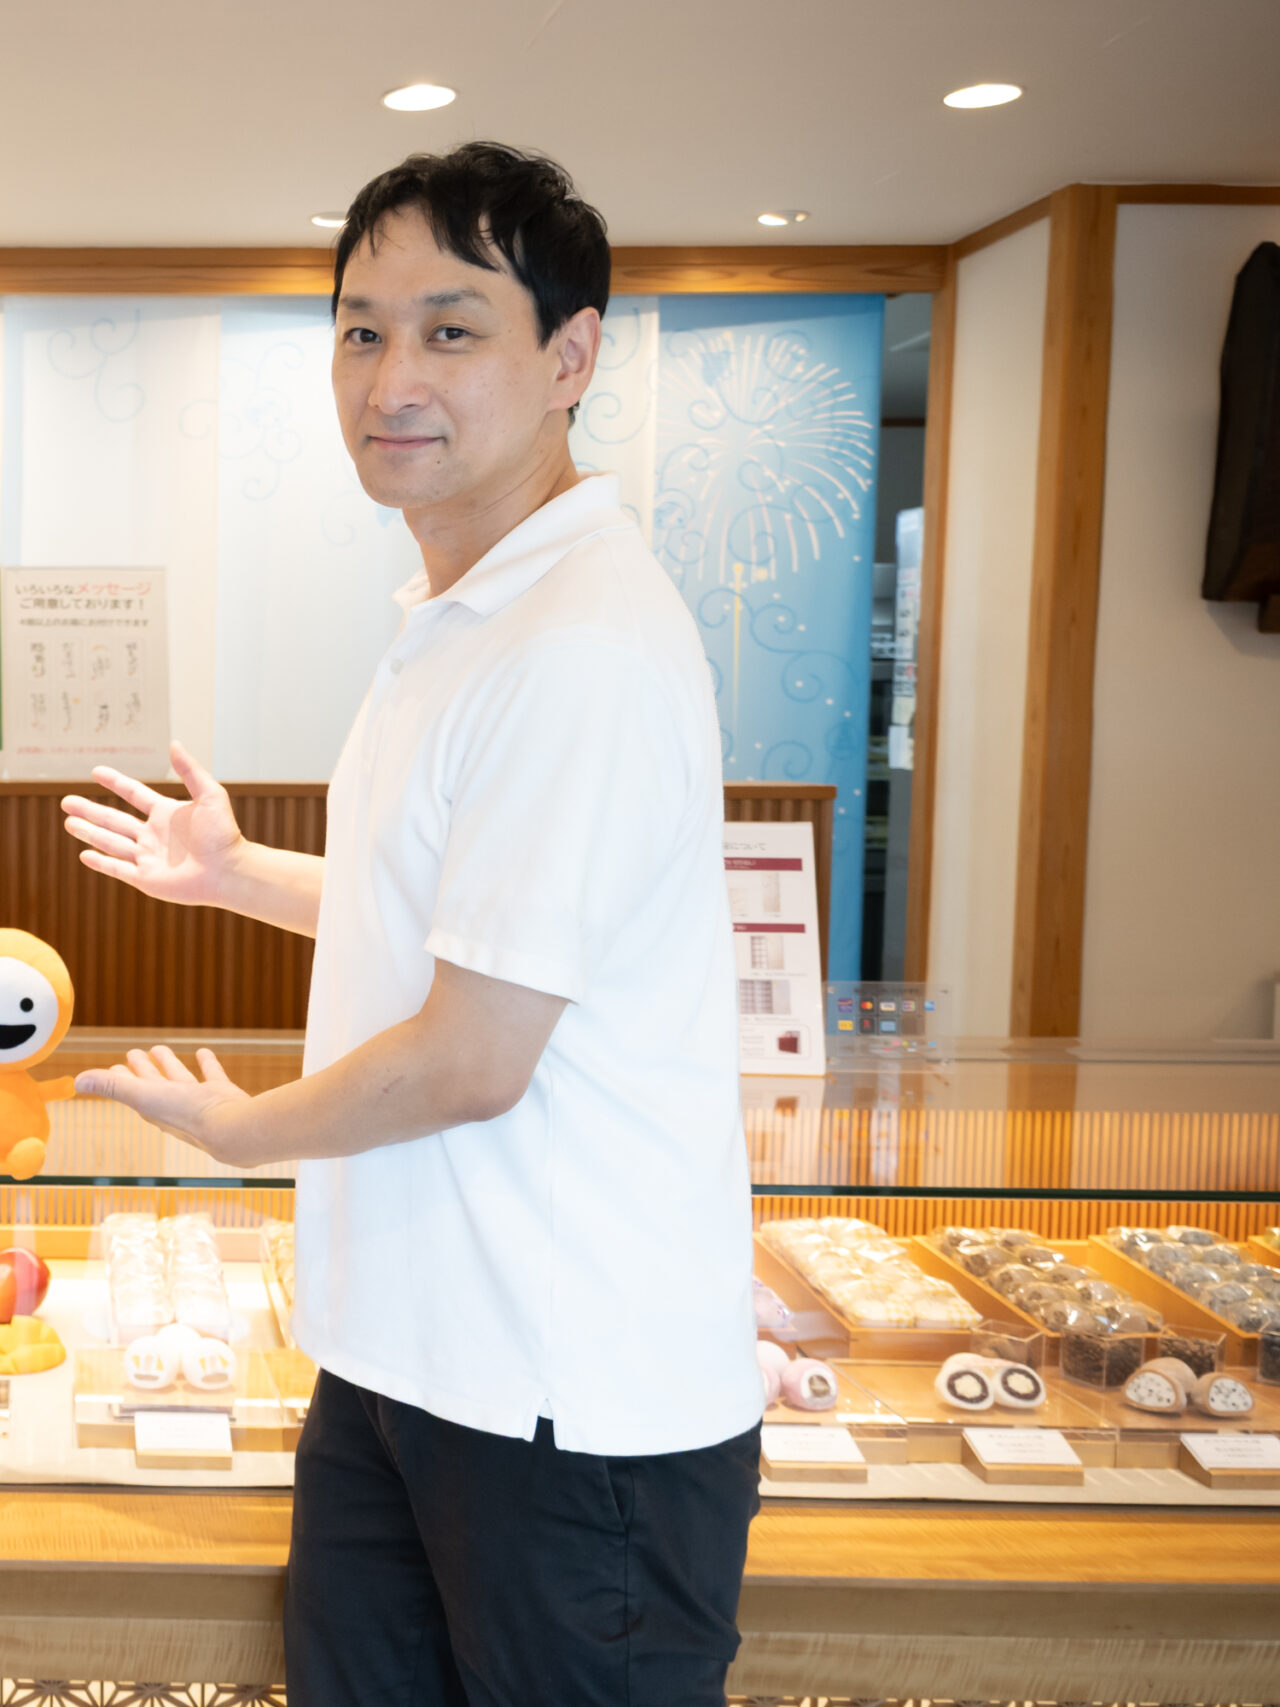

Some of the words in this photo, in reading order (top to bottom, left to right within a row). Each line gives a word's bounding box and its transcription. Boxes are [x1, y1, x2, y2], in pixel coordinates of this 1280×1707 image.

[15, 582, 152, 595] いろいろなメッセージ
